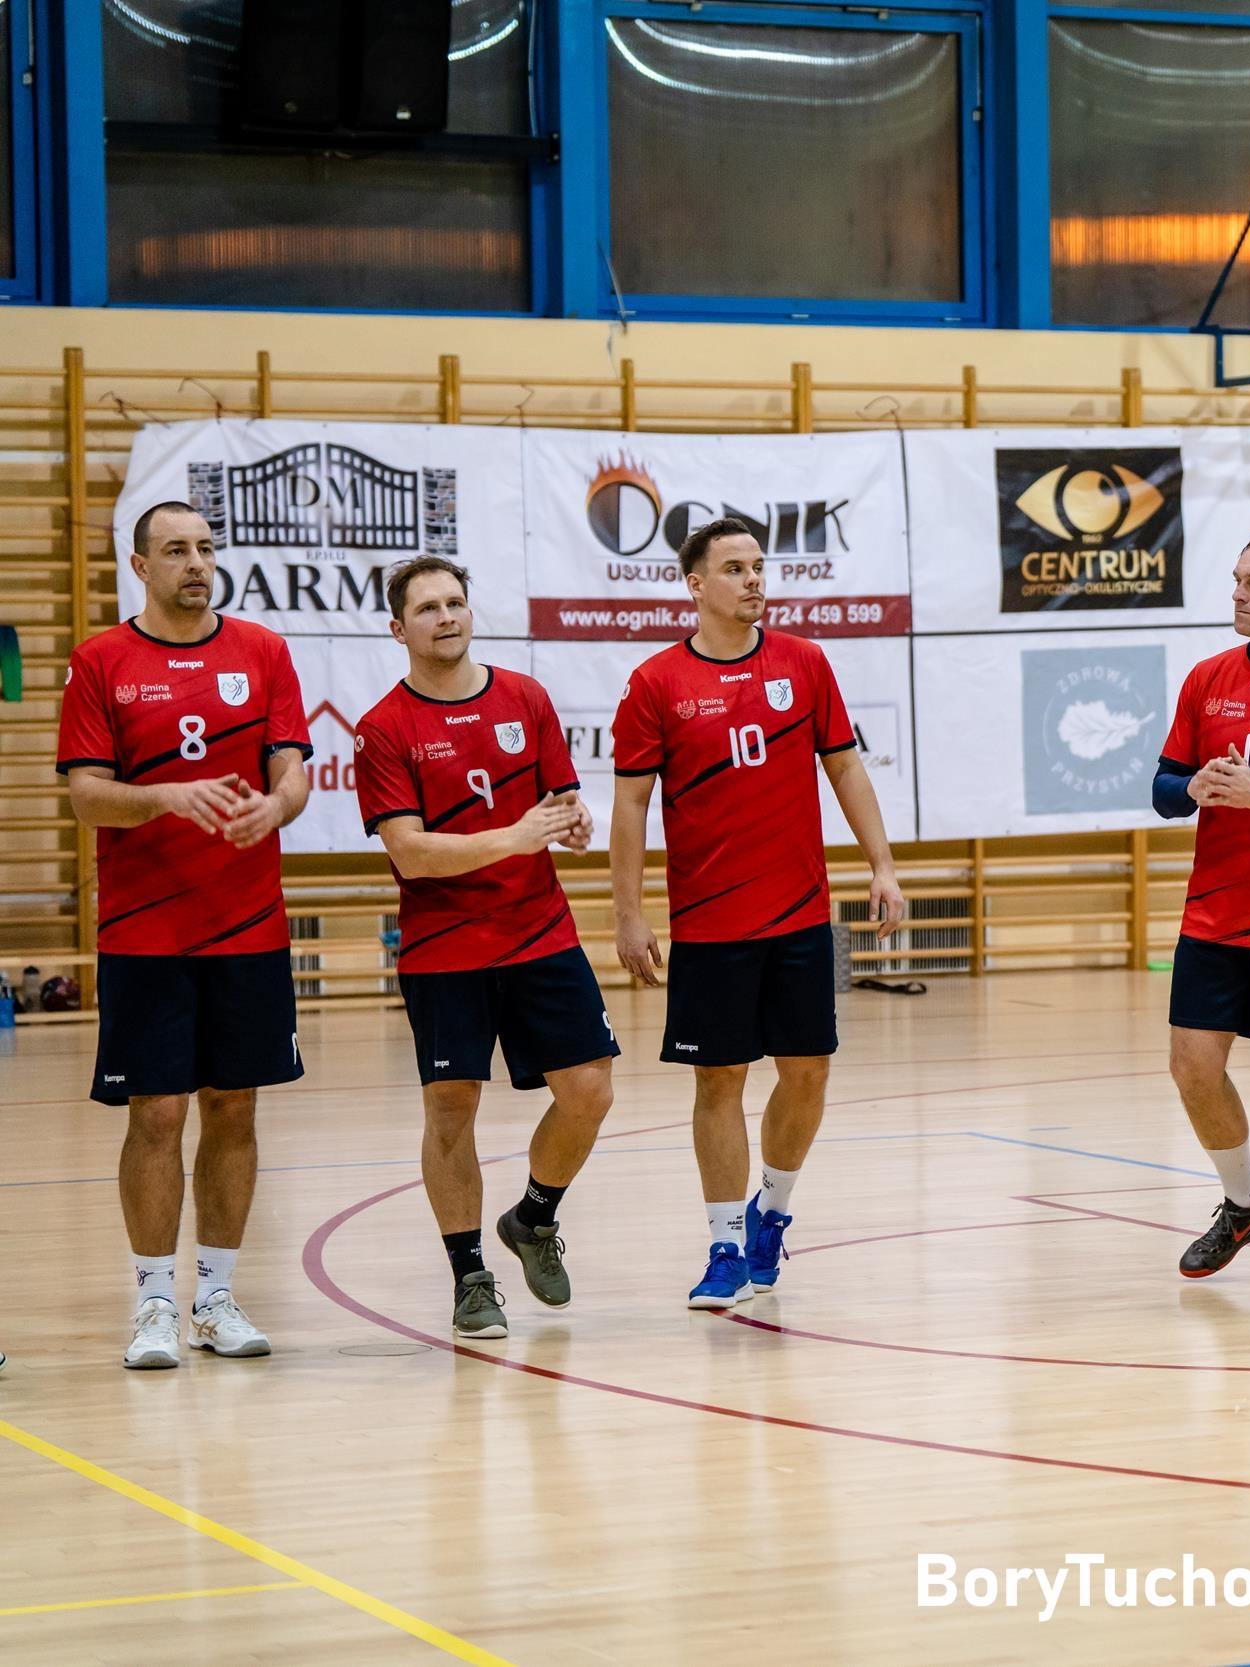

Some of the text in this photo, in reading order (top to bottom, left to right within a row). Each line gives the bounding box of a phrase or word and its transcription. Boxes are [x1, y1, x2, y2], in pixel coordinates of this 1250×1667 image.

[289, 474, 365, 509] DM
[586, 479, 850, 557] OGNIK
[781, 559, 834, 580] PPOŻ
[1021, 549, 1166, 582] CENTRUM
[559, 603, 884, 633] www.ognik.or 724 459 599
[168, 659, 204, 669] Kempa
[720, 672, 752, 683] Kempa
[140, 684, 169, 693] Gmina
[141, 692, 172, 702] Czersk
[698, 697, 724, 707] Gmina
[1223, 699, 1246, 709] Gmina
[700, 706, 727, 716] Czersk
[1221, 708, 1245, 718] Czersk
[445, 713, 481, 725] Kempa
[178, 715, 207, 761] 8
[424, 741, 452, 751] Gmina
[728, 723, 767, 769] 10
[427, 749, 457, 760] Czersk
[466, 768, 495, 810] 9
[675, 1041, 699, 1052] Kempa
[104, 1074, 126, 1083] Kempa
